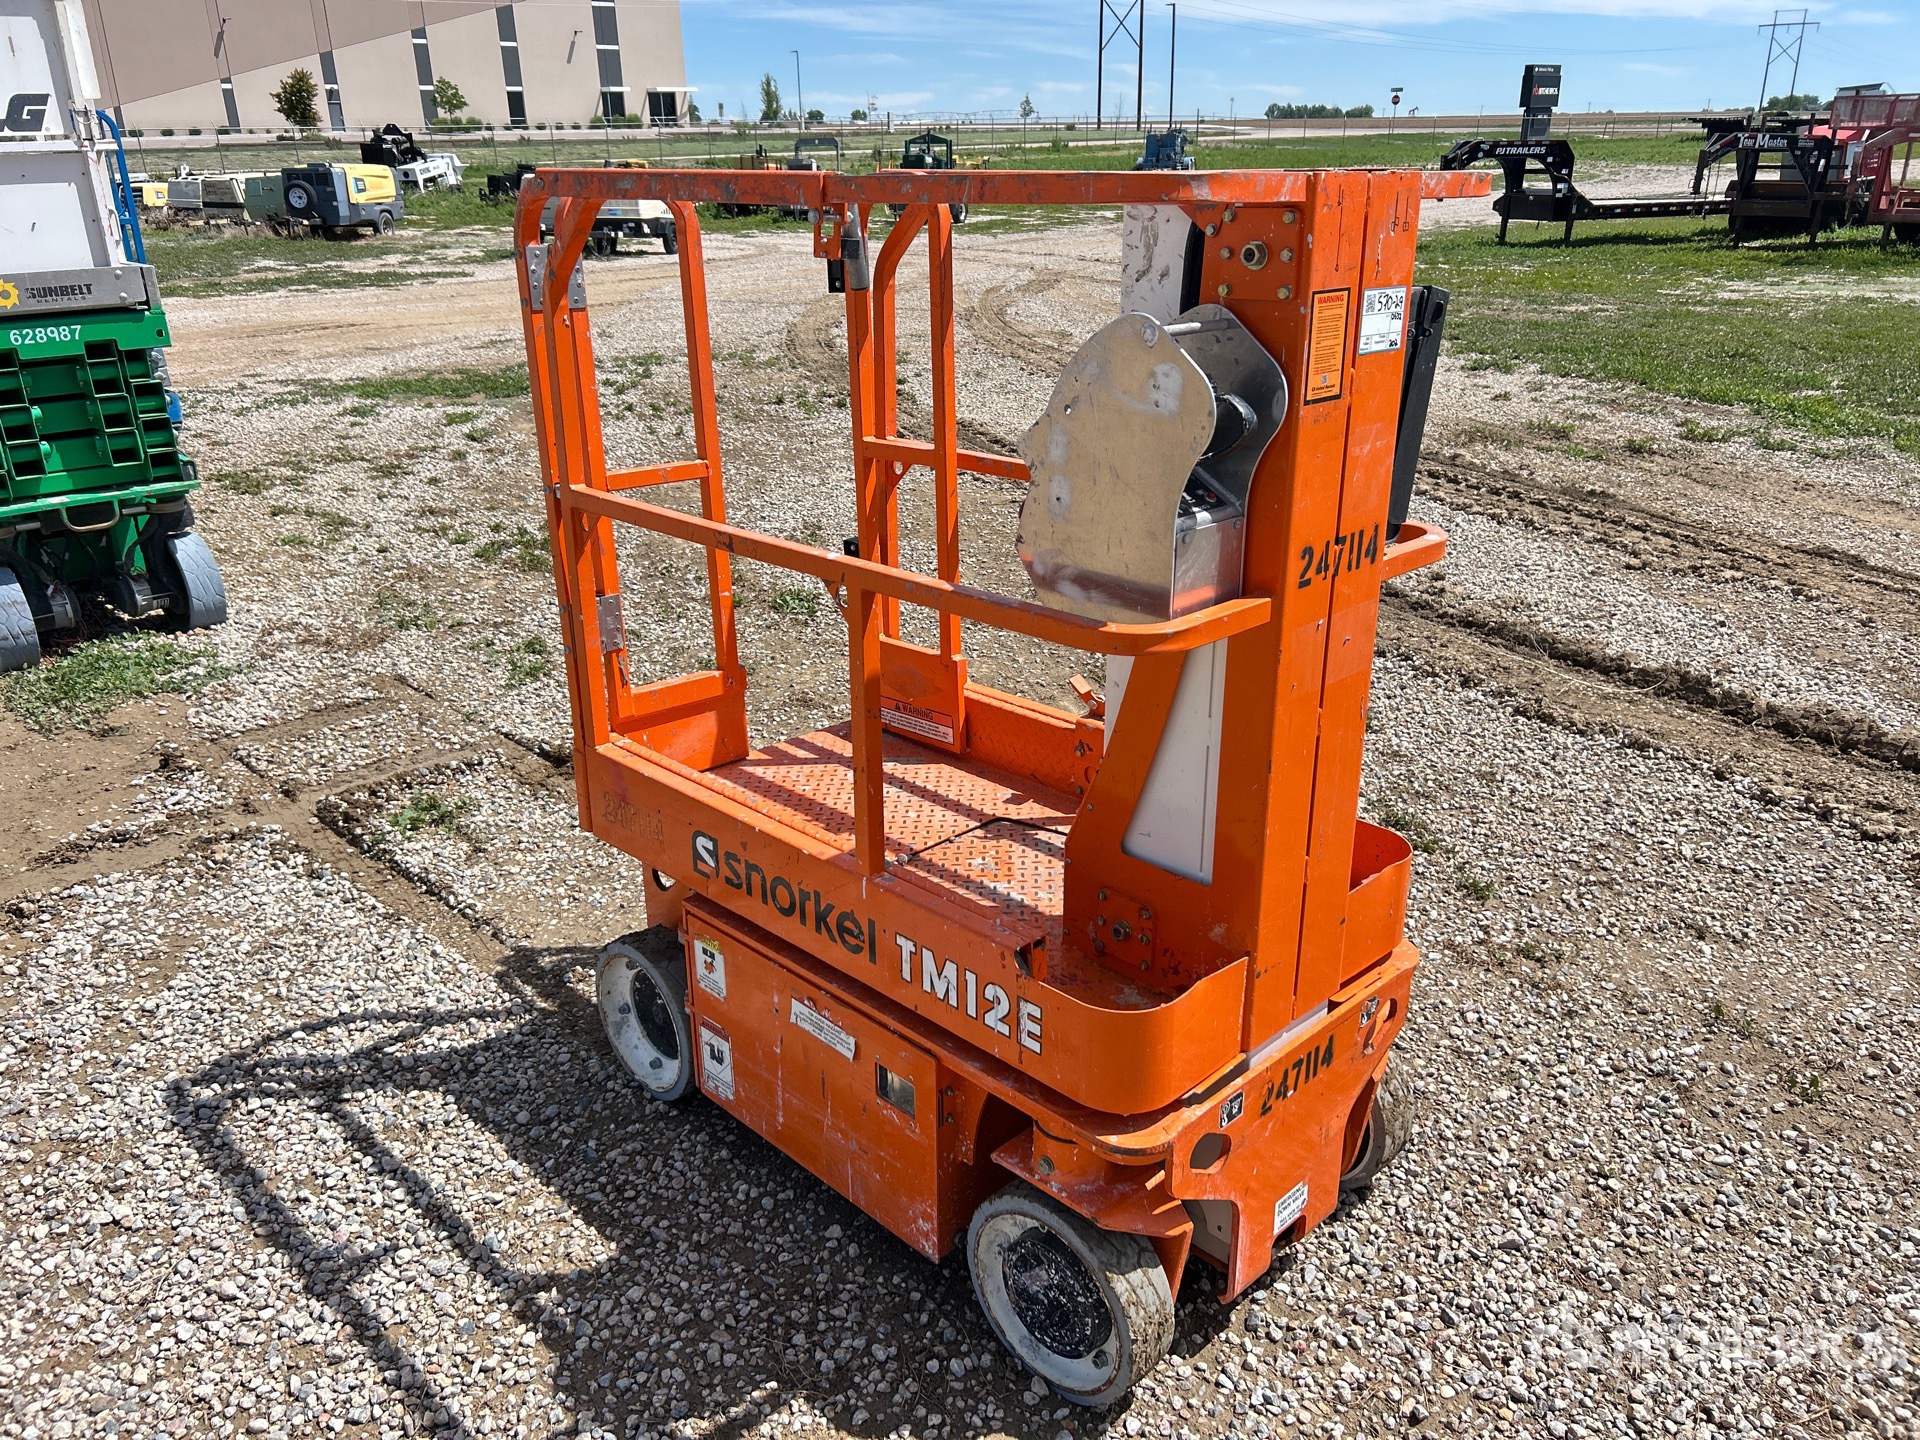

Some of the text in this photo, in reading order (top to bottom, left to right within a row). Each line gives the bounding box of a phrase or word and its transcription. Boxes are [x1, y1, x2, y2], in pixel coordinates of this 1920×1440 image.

[0, 93, 51, 132] G
[1495, 146, 1546, 155] PJ TRAILERS
[1738, 133, 1755, 149] Tow
[1755, 133, 1788, 149] Master
[24, 283, 93, 299] SUNBELT
[36, 296, 87, 304] RENTALS
[1318, 294, 1344, 304] WARNING
[9, 324, 83, 346] 628987
[1297, 522, 1379, 589] 247114
[902, 703, 934, 720] WARNING
[723, 850, 878, 966] snorkel
[895, 931, 1044, 1057] TM12E
[1260, 1034, 1334, 1117] 247114
